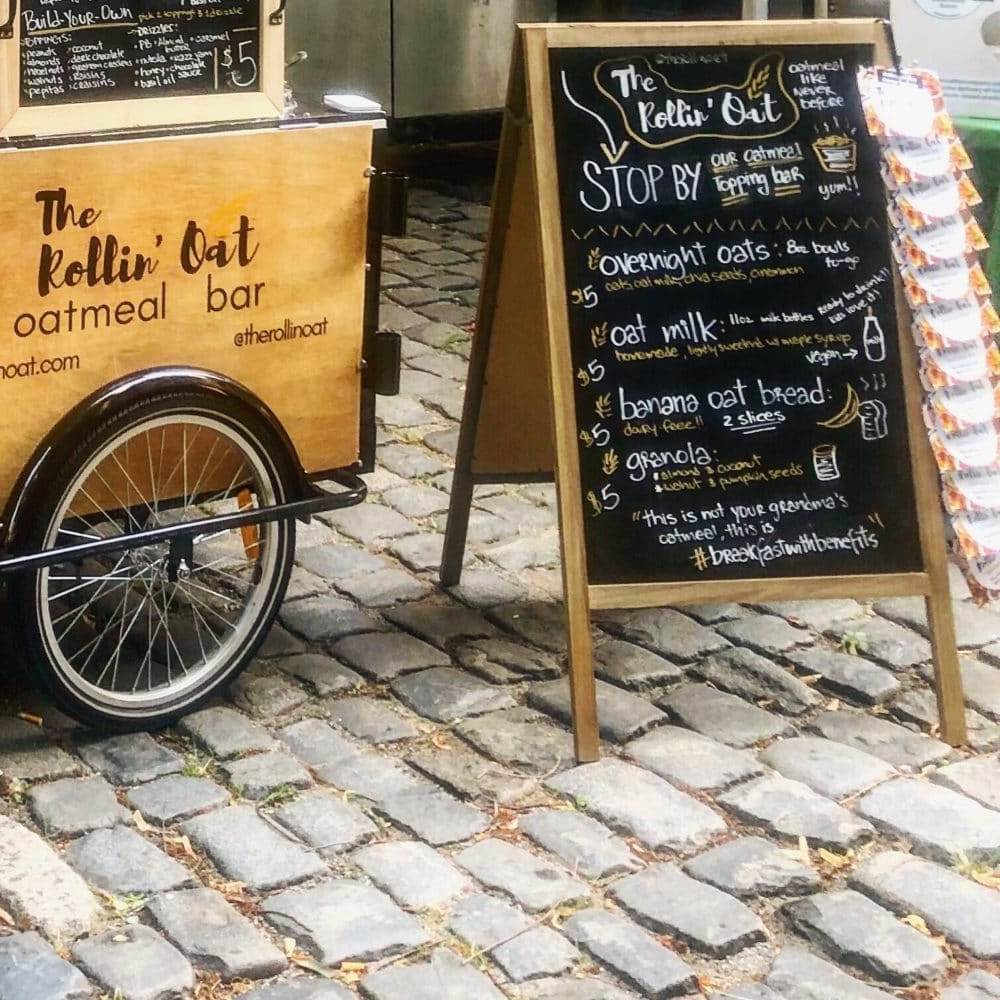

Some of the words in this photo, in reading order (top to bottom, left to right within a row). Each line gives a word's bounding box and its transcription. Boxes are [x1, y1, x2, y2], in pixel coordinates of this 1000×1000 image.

[27, 58, 60, 67] almonds
[71, 53, 91, 63] dark
[72, 41, 103, 53] coconut
[788, 58, 845, 74] oatmeal
[800, 73, 827, 85] like
[28, 75, 63, 86] walnuts
[28, 85, 65, 99] pepitas
[611, 64, 657, 98] The
[637, 96, 714, 133] Rollin'
[721, 92, 782, 127] Oat
[743, 142, 803, 163] oatmeal
[580, 160, 664, 212] STOP
[672, 162, 702, 201] BY
[818, 174, 860, 201] yum!!
[35, 187, 101, 235] The
[37, 234, 163, 297] Rollin'
[180, 215, 259, 274] Oat
[599, 241, 707, 282] overnight
[812, 240, 850, 255] bowls
[824, 256, 860, 271] to-go
[14, 282, 166, 338] oatmeal
[207, 274, 265, 313] bar
[233, 317, 328, 347] @therollinoat
[609, 312, 647, 347] oat
[660, 310, 726, 344] milk:
[577, 358, 606, 387] $5
[619, 386, 700, 421] banana
[707, 378, 748, 410] oat
[723, 415, 734, 427] 2
[737, 410, 787, 425] slices
[579, 422, 611, 448] $5
[768, 461, 804, 480] seeds
[586, 483, 621, 517] $5
[681, 503, 698, 517] is
[701, 502, 725, 518] not
[768, 491, 849, 521] grandma's
[723, 524, 758, 539] this
[761, 520, 775, 534] is
